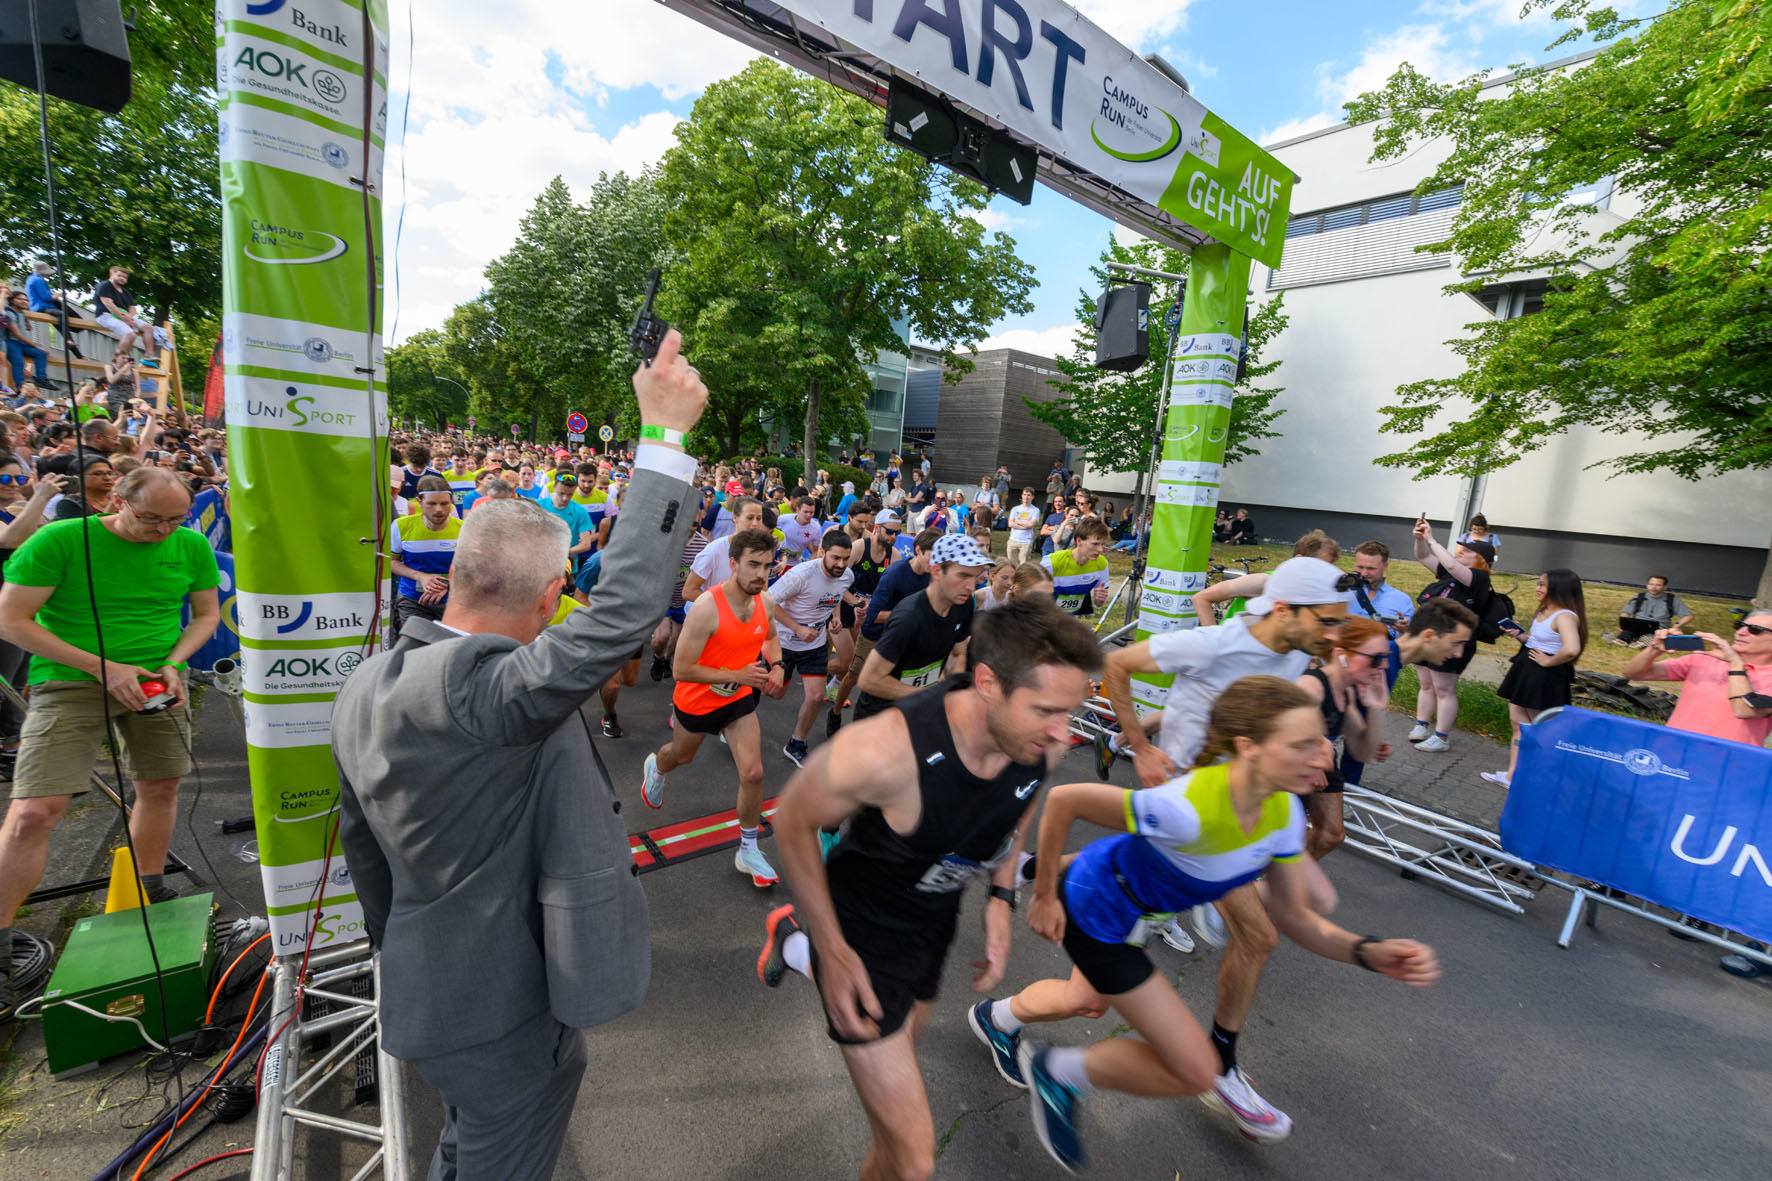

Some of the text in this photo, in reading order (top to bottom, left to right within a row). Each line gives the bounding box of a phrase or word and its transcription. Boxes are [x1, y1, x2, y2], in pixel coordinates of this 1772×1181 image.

[291, 7, 348, 48] Bank
[234, 46, 309, 89] AOK
[853, 0, 1087, 131] ART
[1238, 160, 1281, 210] AUF
[1176, 363, 1197, 374] AOK
[262, 604, 364, 631] BB Bank
[264, 657, 332, 678] AOK
[264, 682, 279, 690] Die
